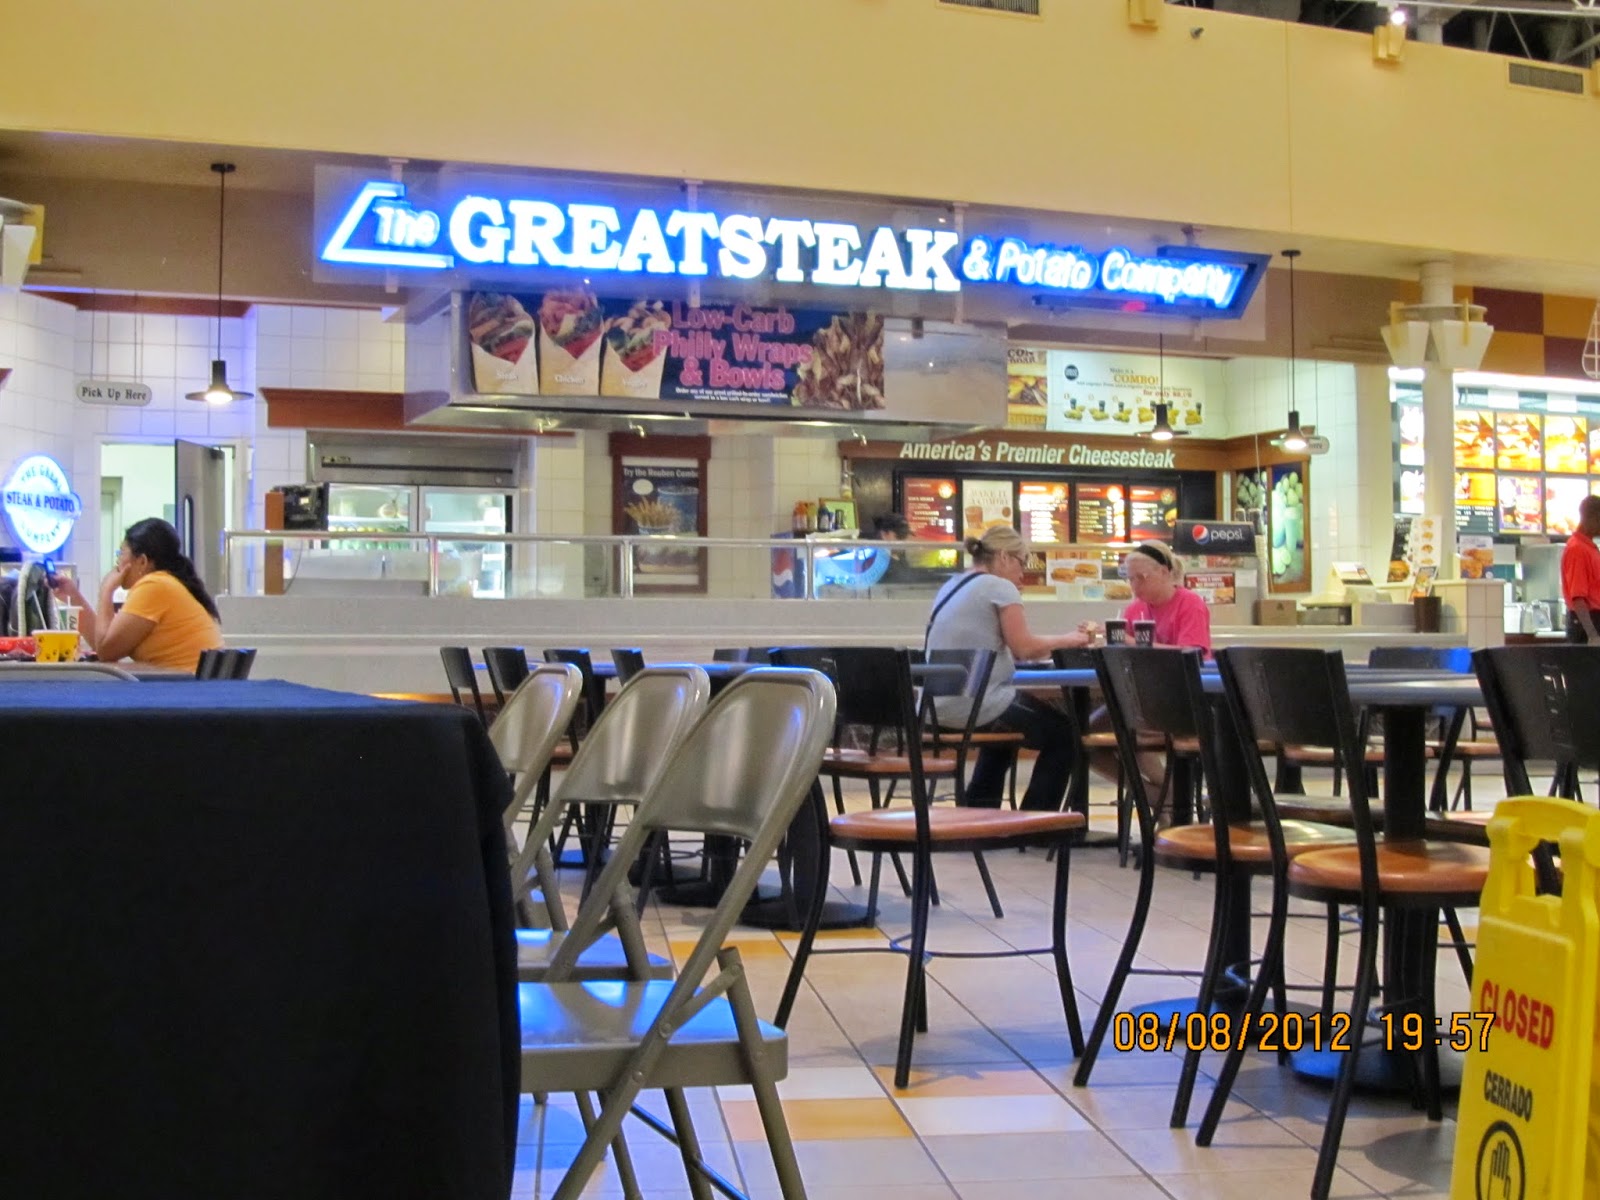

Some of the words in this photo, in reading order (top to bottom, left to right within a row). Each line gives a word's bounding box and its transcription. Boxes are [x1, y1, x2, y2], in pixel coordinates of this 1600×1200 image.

[373, 203, 440, 248] The
[962, 235, 993, 281] &
[996, 238, 1097, 290] Potato
[1101, 247, 1236, 309] Company
[672, 300, 795, 335] Low-Carb
[654, 329, 727, 361] Philly
[731, 332, 814, 368] Wraps
[679, 356, 703, 387] &
[709, 358, 786, 390] Bowls
[1113, 374, 1159, 385] COMBO!
[81, 386, 103, 398] Pick
[107, 387, 121, 401] Up
[125, 388, 147, 400] Here
[900, 439, 991, 462] America's
[996, 441, 1066, 465] Premier
[1069, 443, 1175, 469] Cheesesteak
[623, 467, 634, 478] Try
[635, 467, 647, 477] the
[648, 468, 675, 478] Reuben
[6, 491, 34, 507] STEAK
[35, 493, 42, 508] &
[44, 494, 76, 513] POTATO
[1210, 527, 1243, 542] pepsi
[1480, 979, 1555, 1050] CLOSED
[1484, 1068, 1533, 1123] CERRADO
